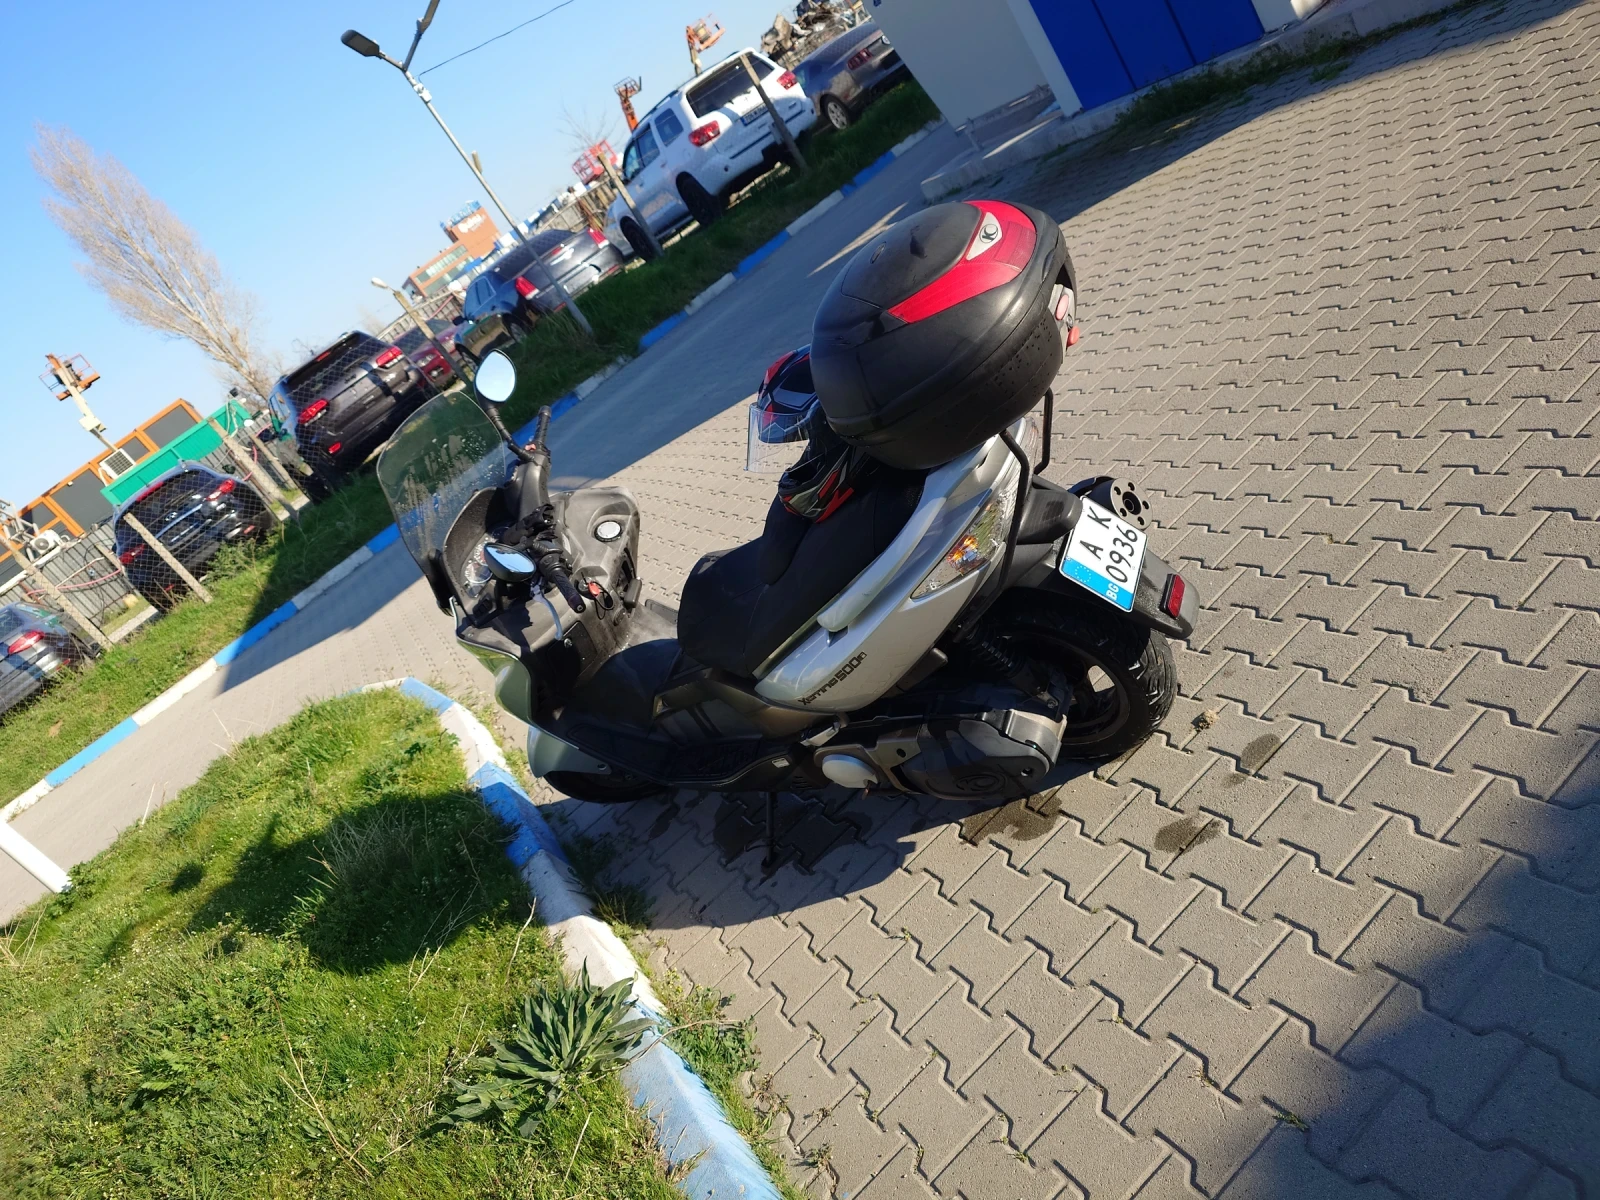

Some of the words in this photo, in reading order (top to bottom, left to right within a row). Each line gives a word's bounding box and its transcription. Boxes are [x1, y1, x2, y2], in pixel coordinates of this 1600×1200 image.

[1087, 506, 1112, 530] K
[1079, 540, 1104, 561] A
[1105, 524, 1138, 584] 0936
[1105, 582, 1120, 601] BG
